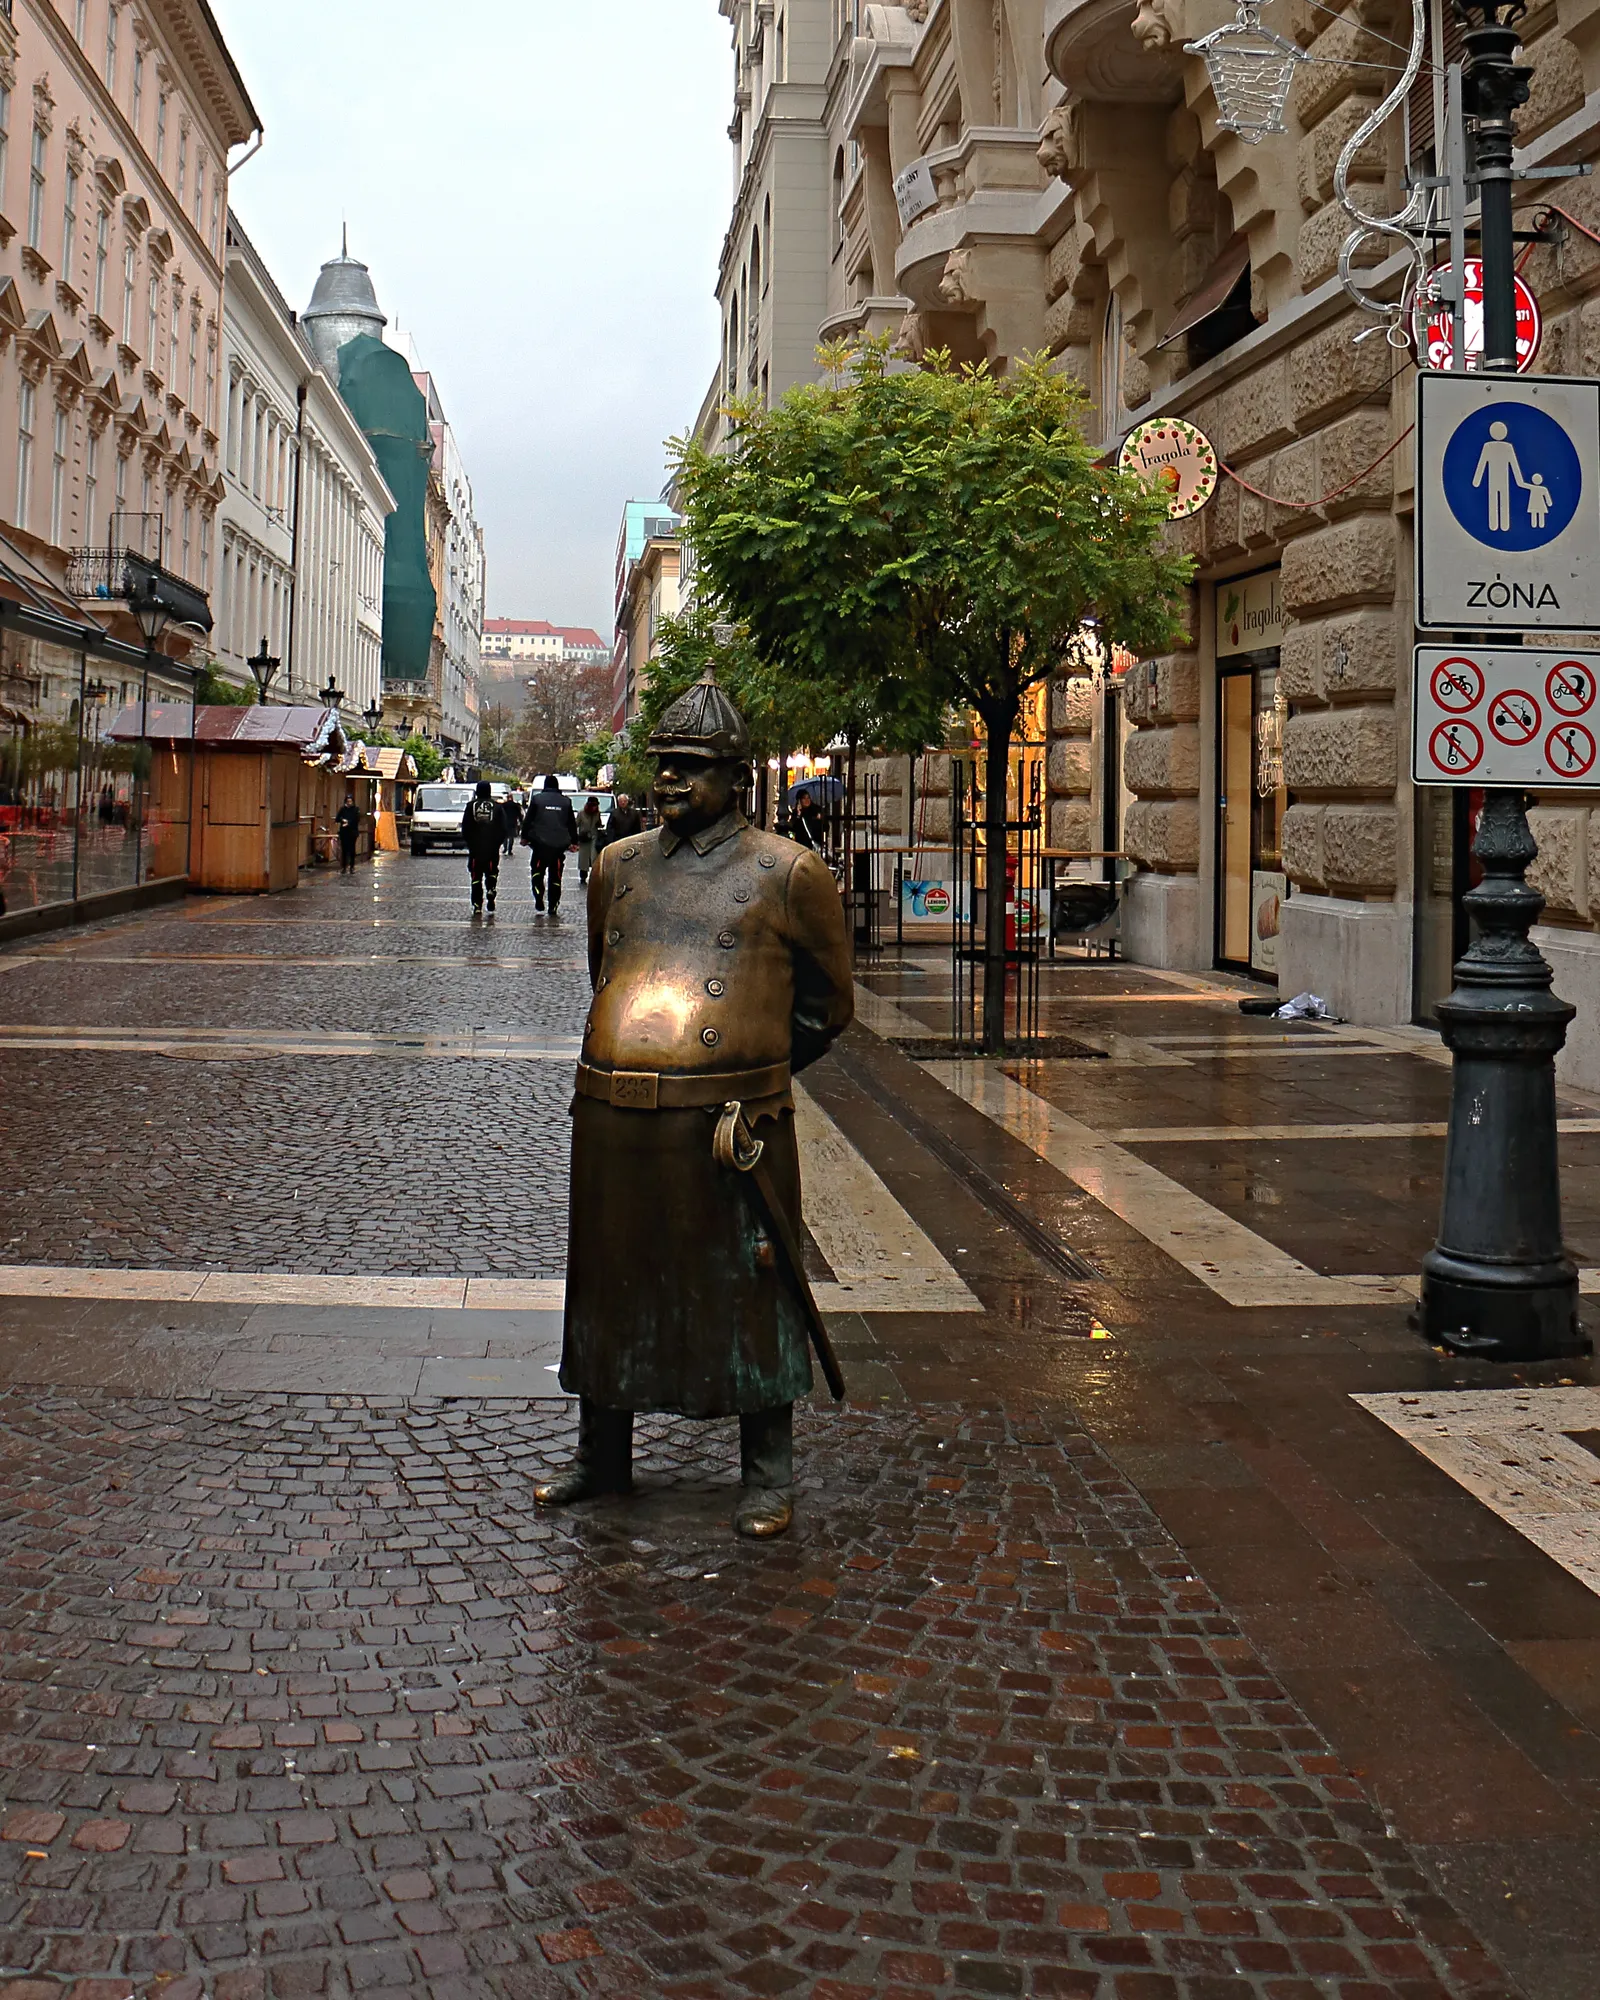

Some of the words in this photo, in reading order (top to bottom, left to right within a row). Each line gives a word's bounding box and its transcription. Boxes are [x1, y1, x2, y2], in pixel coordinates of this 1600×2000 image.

[1140, 439, 1191, 469] fragola
[1243, 581, 1281, 637] fragola
[1466, 573, 1561, 609] ZÓNA
